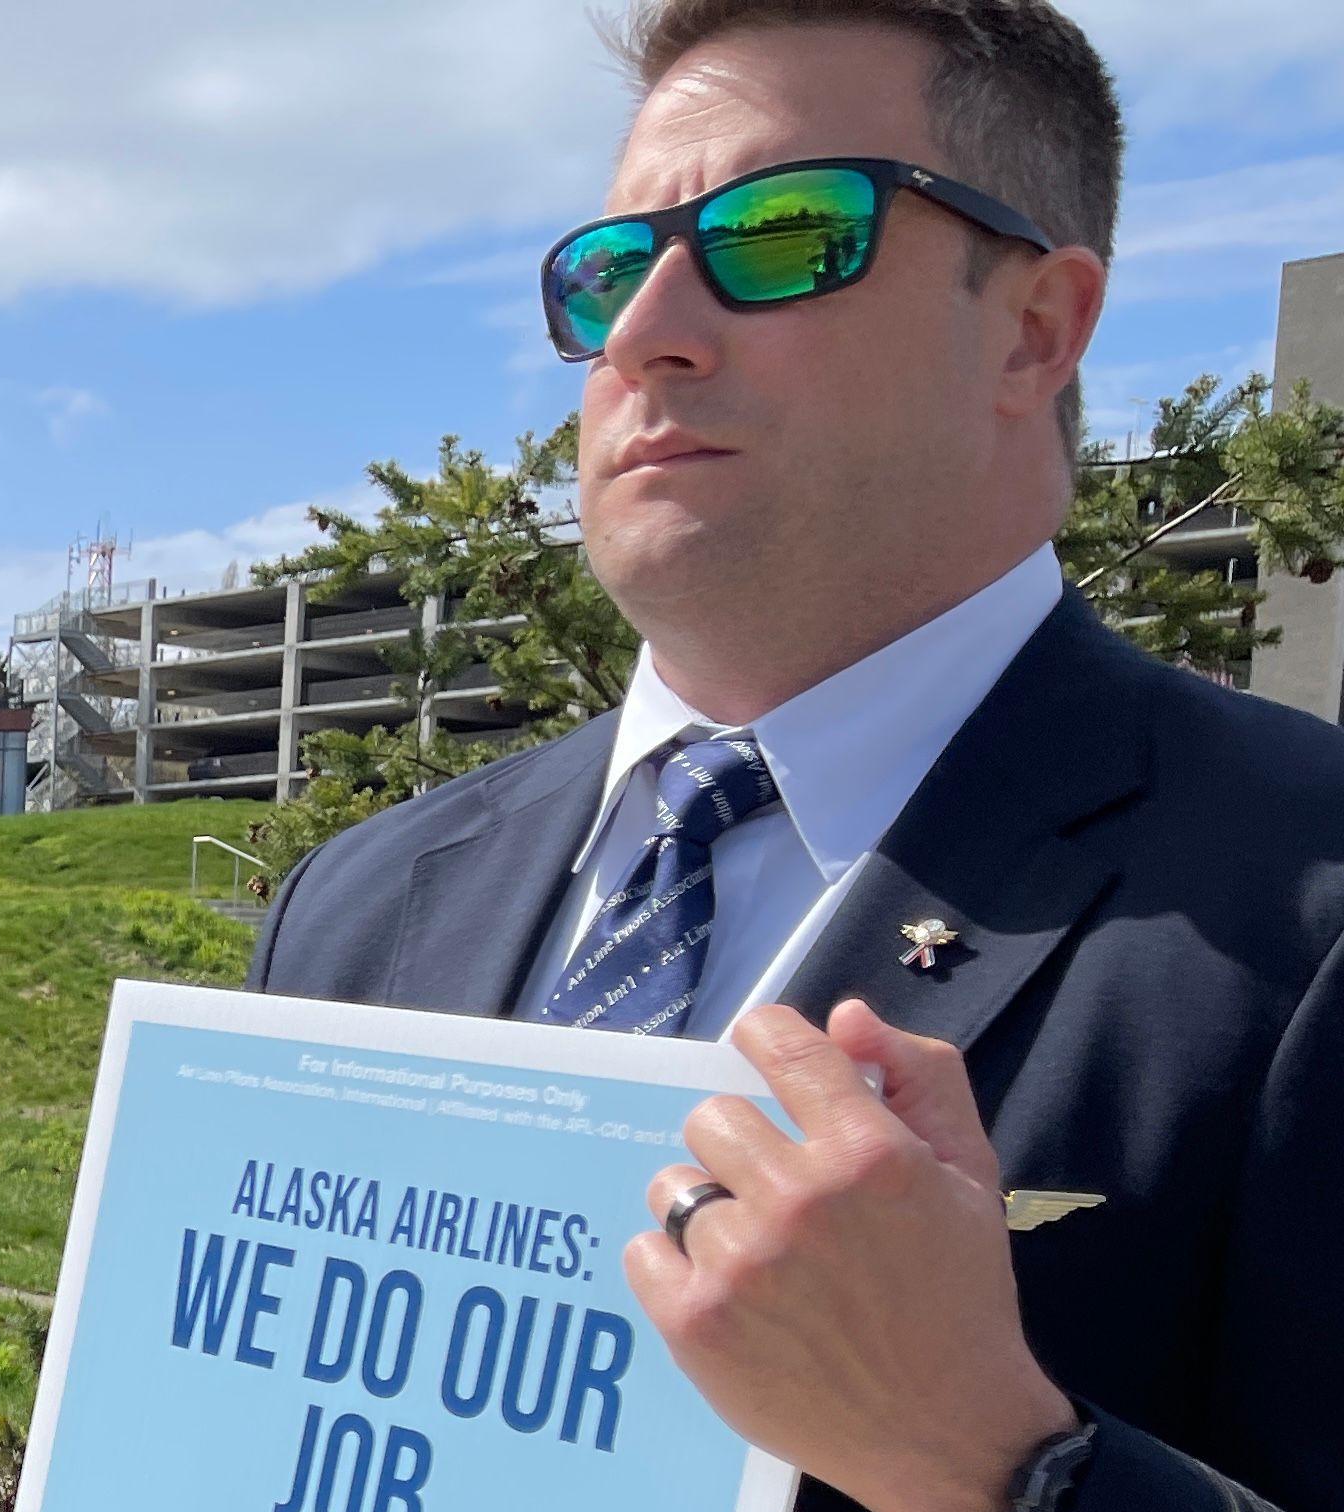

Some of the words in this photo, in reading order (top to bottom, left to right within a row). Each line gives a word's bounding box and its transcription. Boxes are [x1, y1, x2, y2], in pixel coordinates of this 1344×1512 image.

[298, 1054, 328, 1074] For
[330, 1058, 444, 1089] Informational
[450, 1073, 538, 1103] Purposes
[543, 1085, 590, 1113] Only
[563, 1118, 630, 1141] AFL-CIO
[231, 1159, 379, 1241] ALASKA
[391, 1186, 601, 1282] AIRLINES:
[170, 1228, 297, 1371] WE
[303, 1255, 424, 1400] DO
[440, 1285, 636, 1454] OUR
